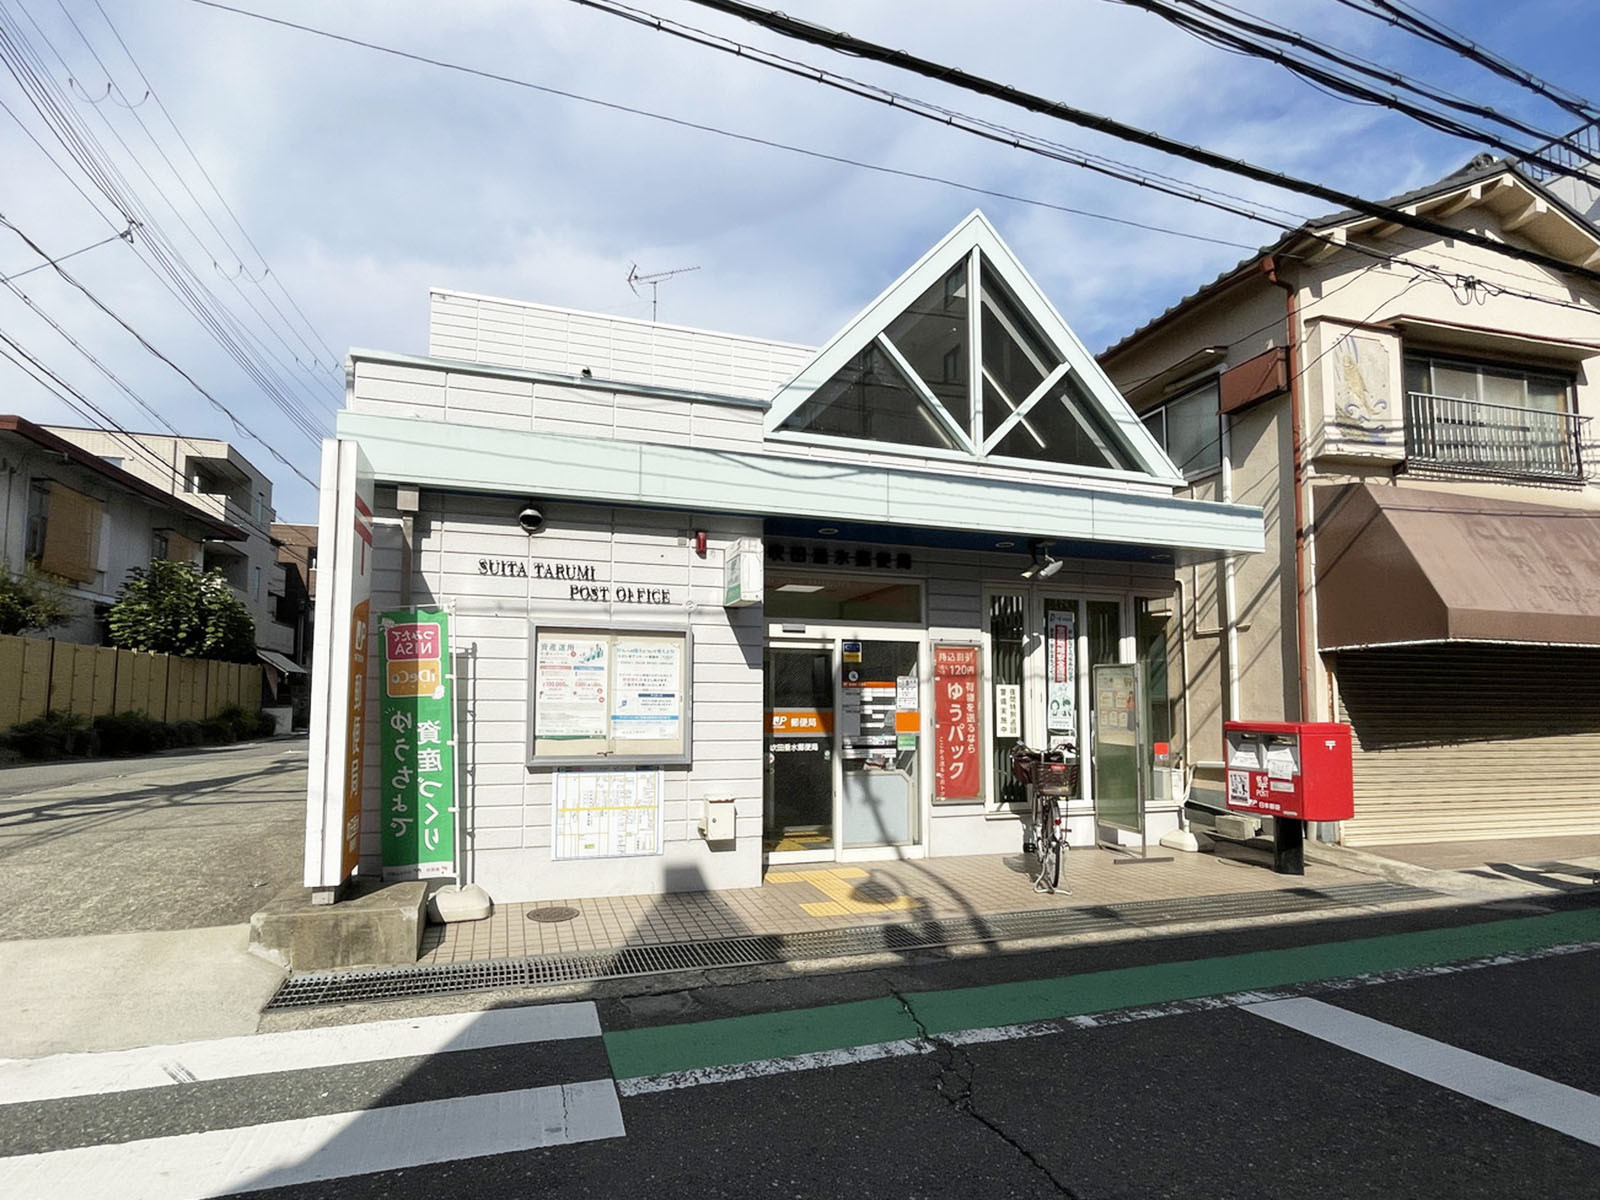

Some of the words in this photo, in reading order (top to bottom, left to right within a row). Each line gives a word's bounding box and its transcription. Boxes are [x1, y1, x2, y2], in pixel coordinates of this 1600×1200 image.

[478, 558, 528, 578] SUITA
[534, 561, 596, 581] TARUMI
[569, 584, 610, 602] POST
[616, 586, 671, 605] OFFICE
[949, 664, 975, 676] 120円
[790, 717, 817, 728] 郵便局
[947, 682, 966, 780] ゆうパック
[769, 742, 819, 752] 吹田垂水郵便局
